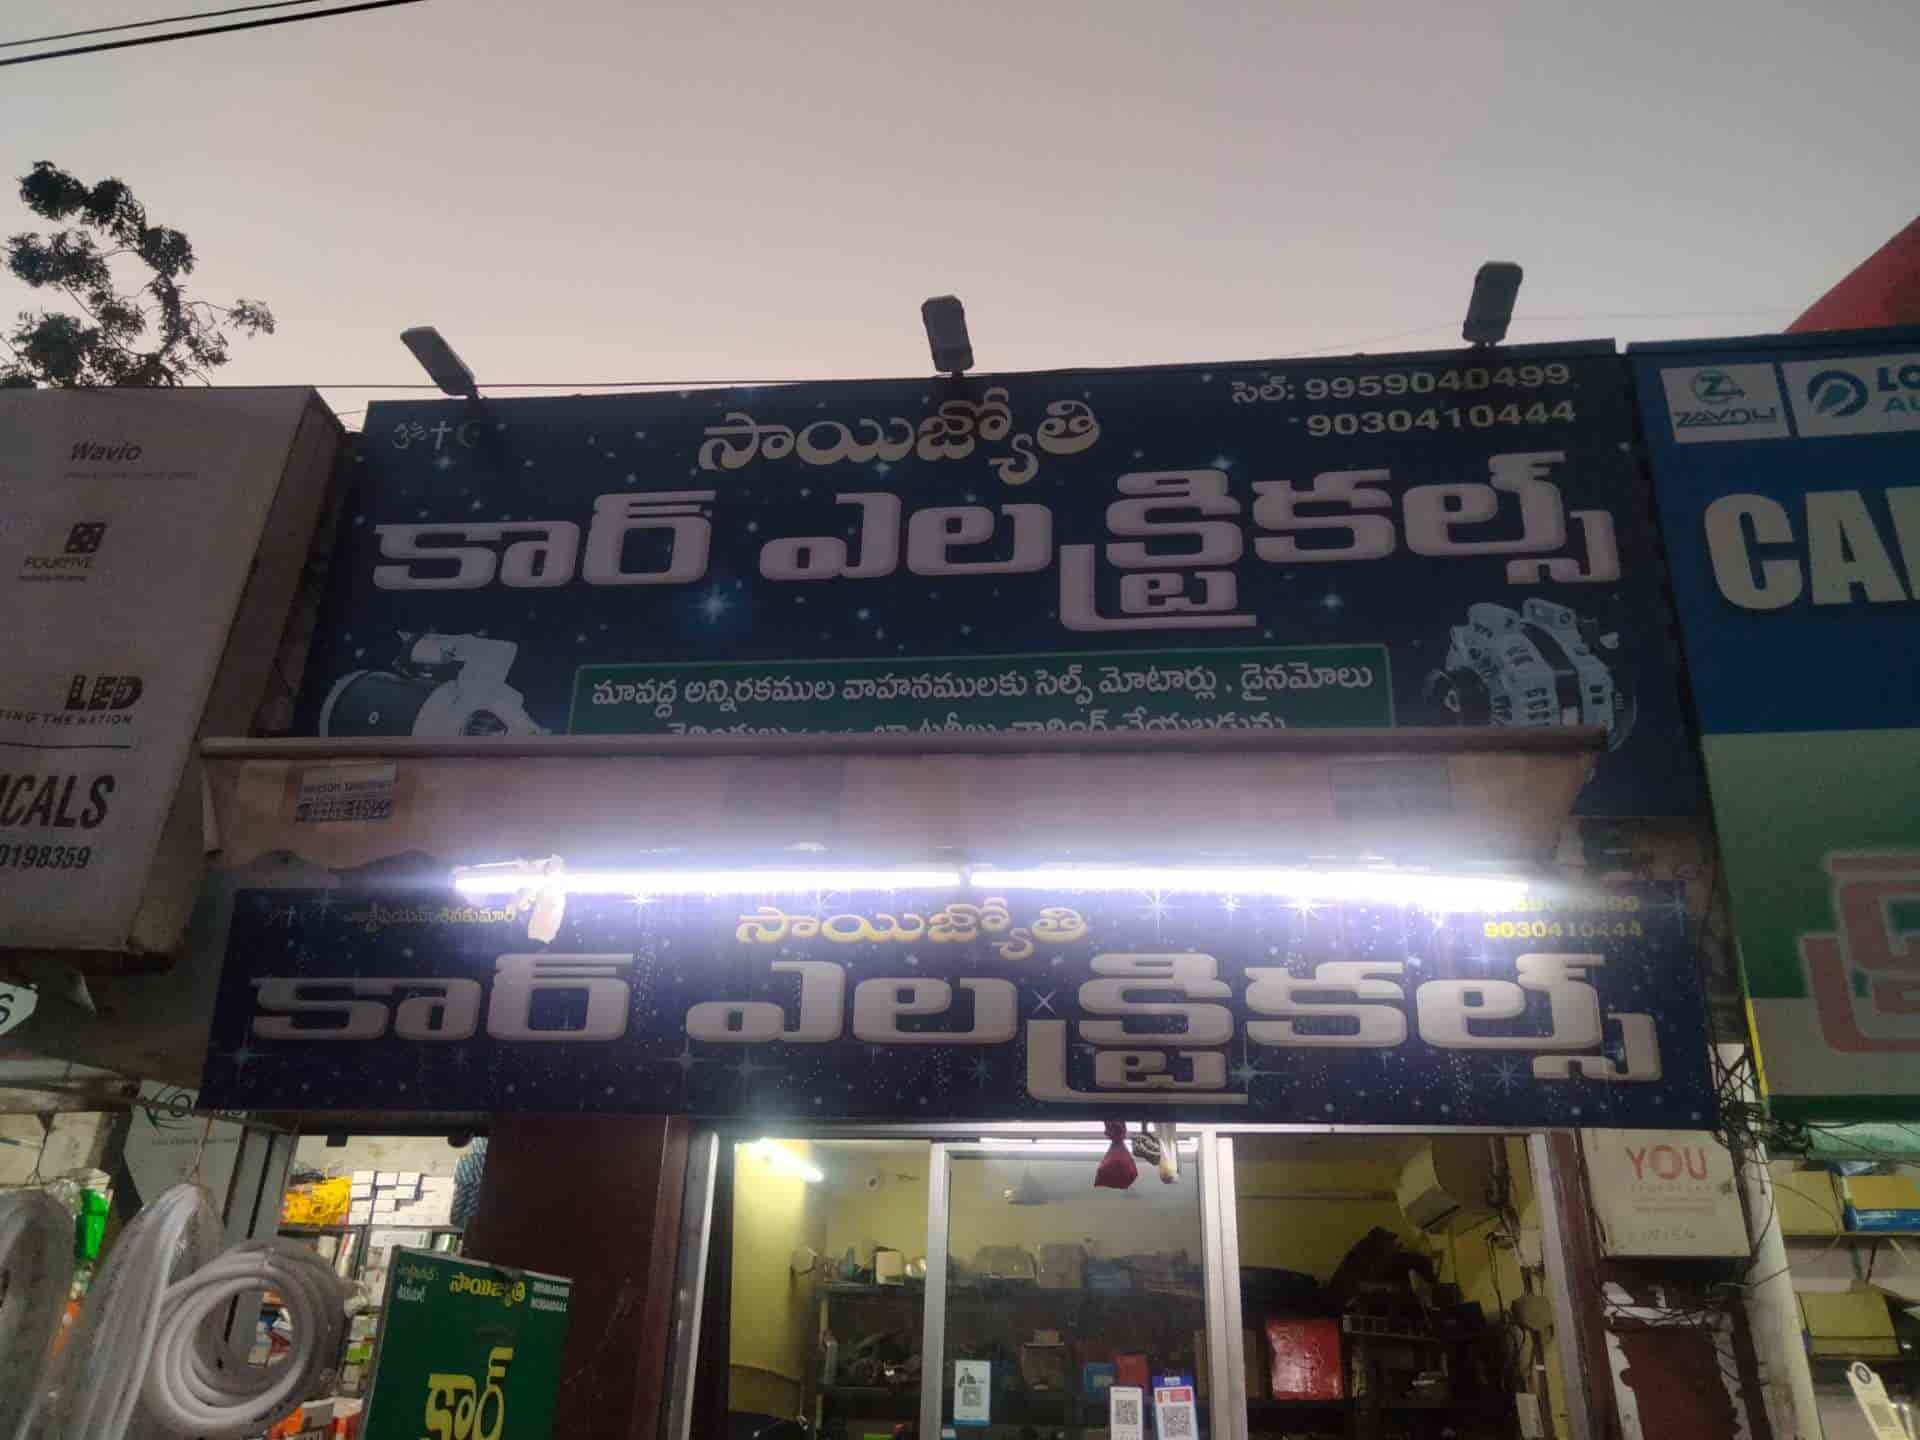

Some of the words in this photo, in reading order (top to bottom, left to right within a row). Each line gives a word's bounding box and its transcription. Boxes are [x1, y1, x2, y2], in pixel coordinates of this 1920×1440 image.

[1304, 363, 1571, 400] 9959040499
[697, 387, 1102, 486] సాయిజ్యోతి
[1306, 399, 1577, 437] 9030410444
[70, 441, 142, 462] Wavio
[372, 490, 717, 590] కార్
[759, 451, 1621, 632] ఎలక్ట్రికల్స్
[64, 674, 144, 711] LED
[736, 896, 1087, 961] సాయిజ్యోతి
[250, 951, 635, 1042] కార్
[686, 951, 1664, 1105] ఎలక్ట్రికల్స్
[1625, 1144, 1708, 1181] YOU
